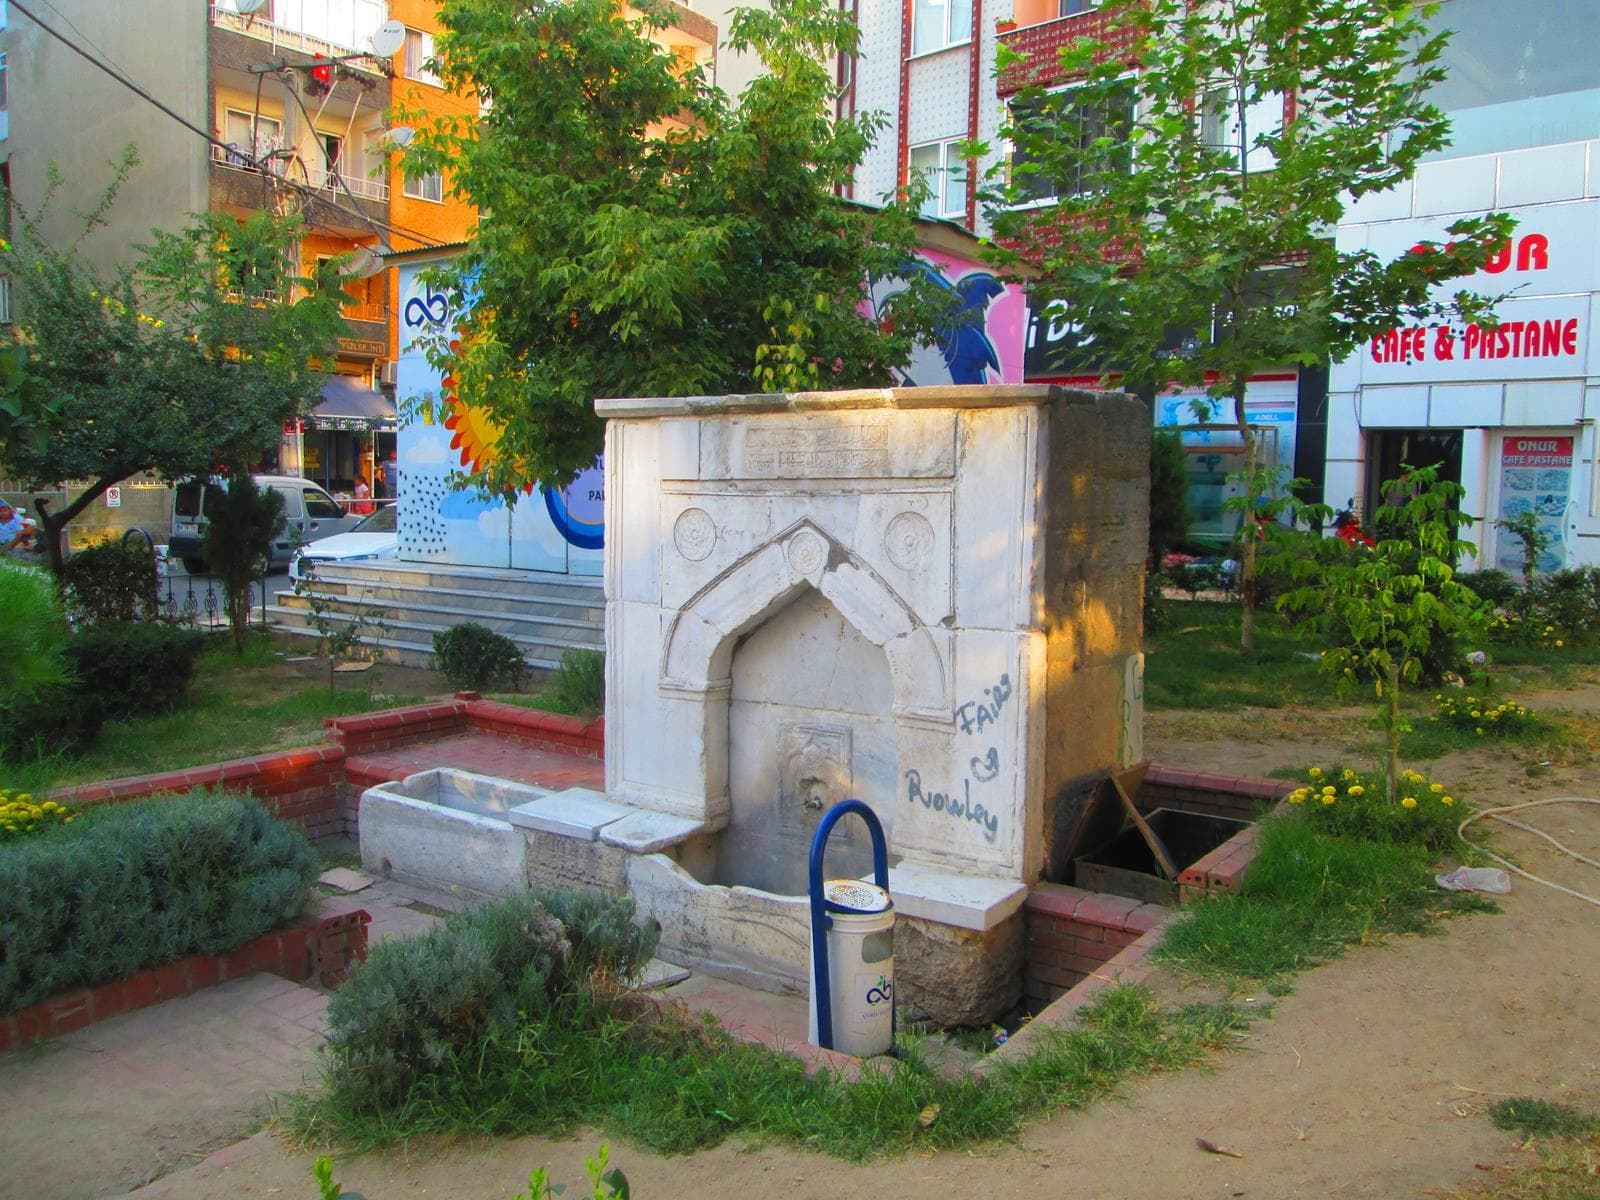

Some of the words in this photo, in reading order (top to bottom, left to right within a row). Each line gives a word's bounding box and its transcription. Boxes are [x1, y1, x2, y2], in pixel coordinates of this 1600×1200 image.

[1409, 233, 1549, 279] UR
[1371, 326, 1426, 363] CAFE
[1434, 326, 1454, 361] &
[1463, 318, 1578, 360] PASTANE
[1503, 455, 1525, 464] CAFE
[1528, 455, 1573, 465] PASTANE
[1517, 440, 1558, 452] ONUR
